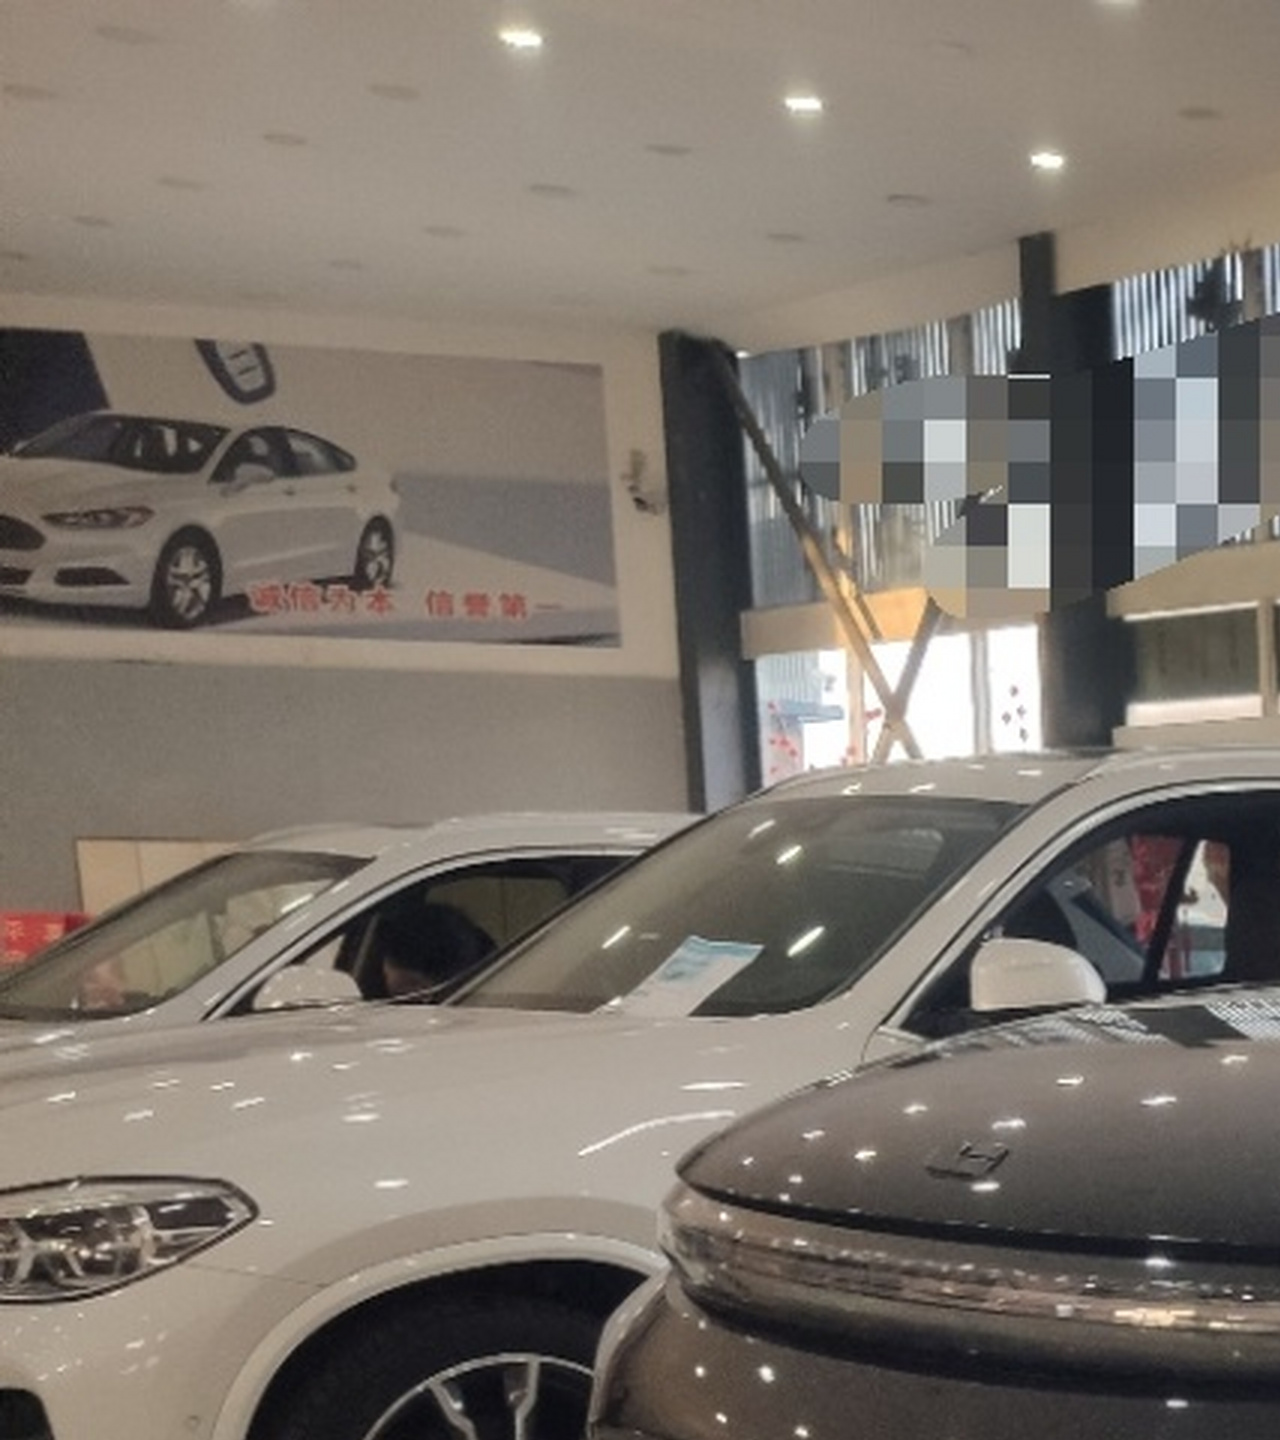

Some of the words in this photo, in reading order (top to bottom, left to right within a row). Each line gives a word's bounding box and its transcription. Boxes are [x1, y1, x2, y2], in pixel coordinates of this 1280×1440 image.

[249, 582, 396, 617] 诚信为本
[425, 589, 563, 620] 信誉第一
